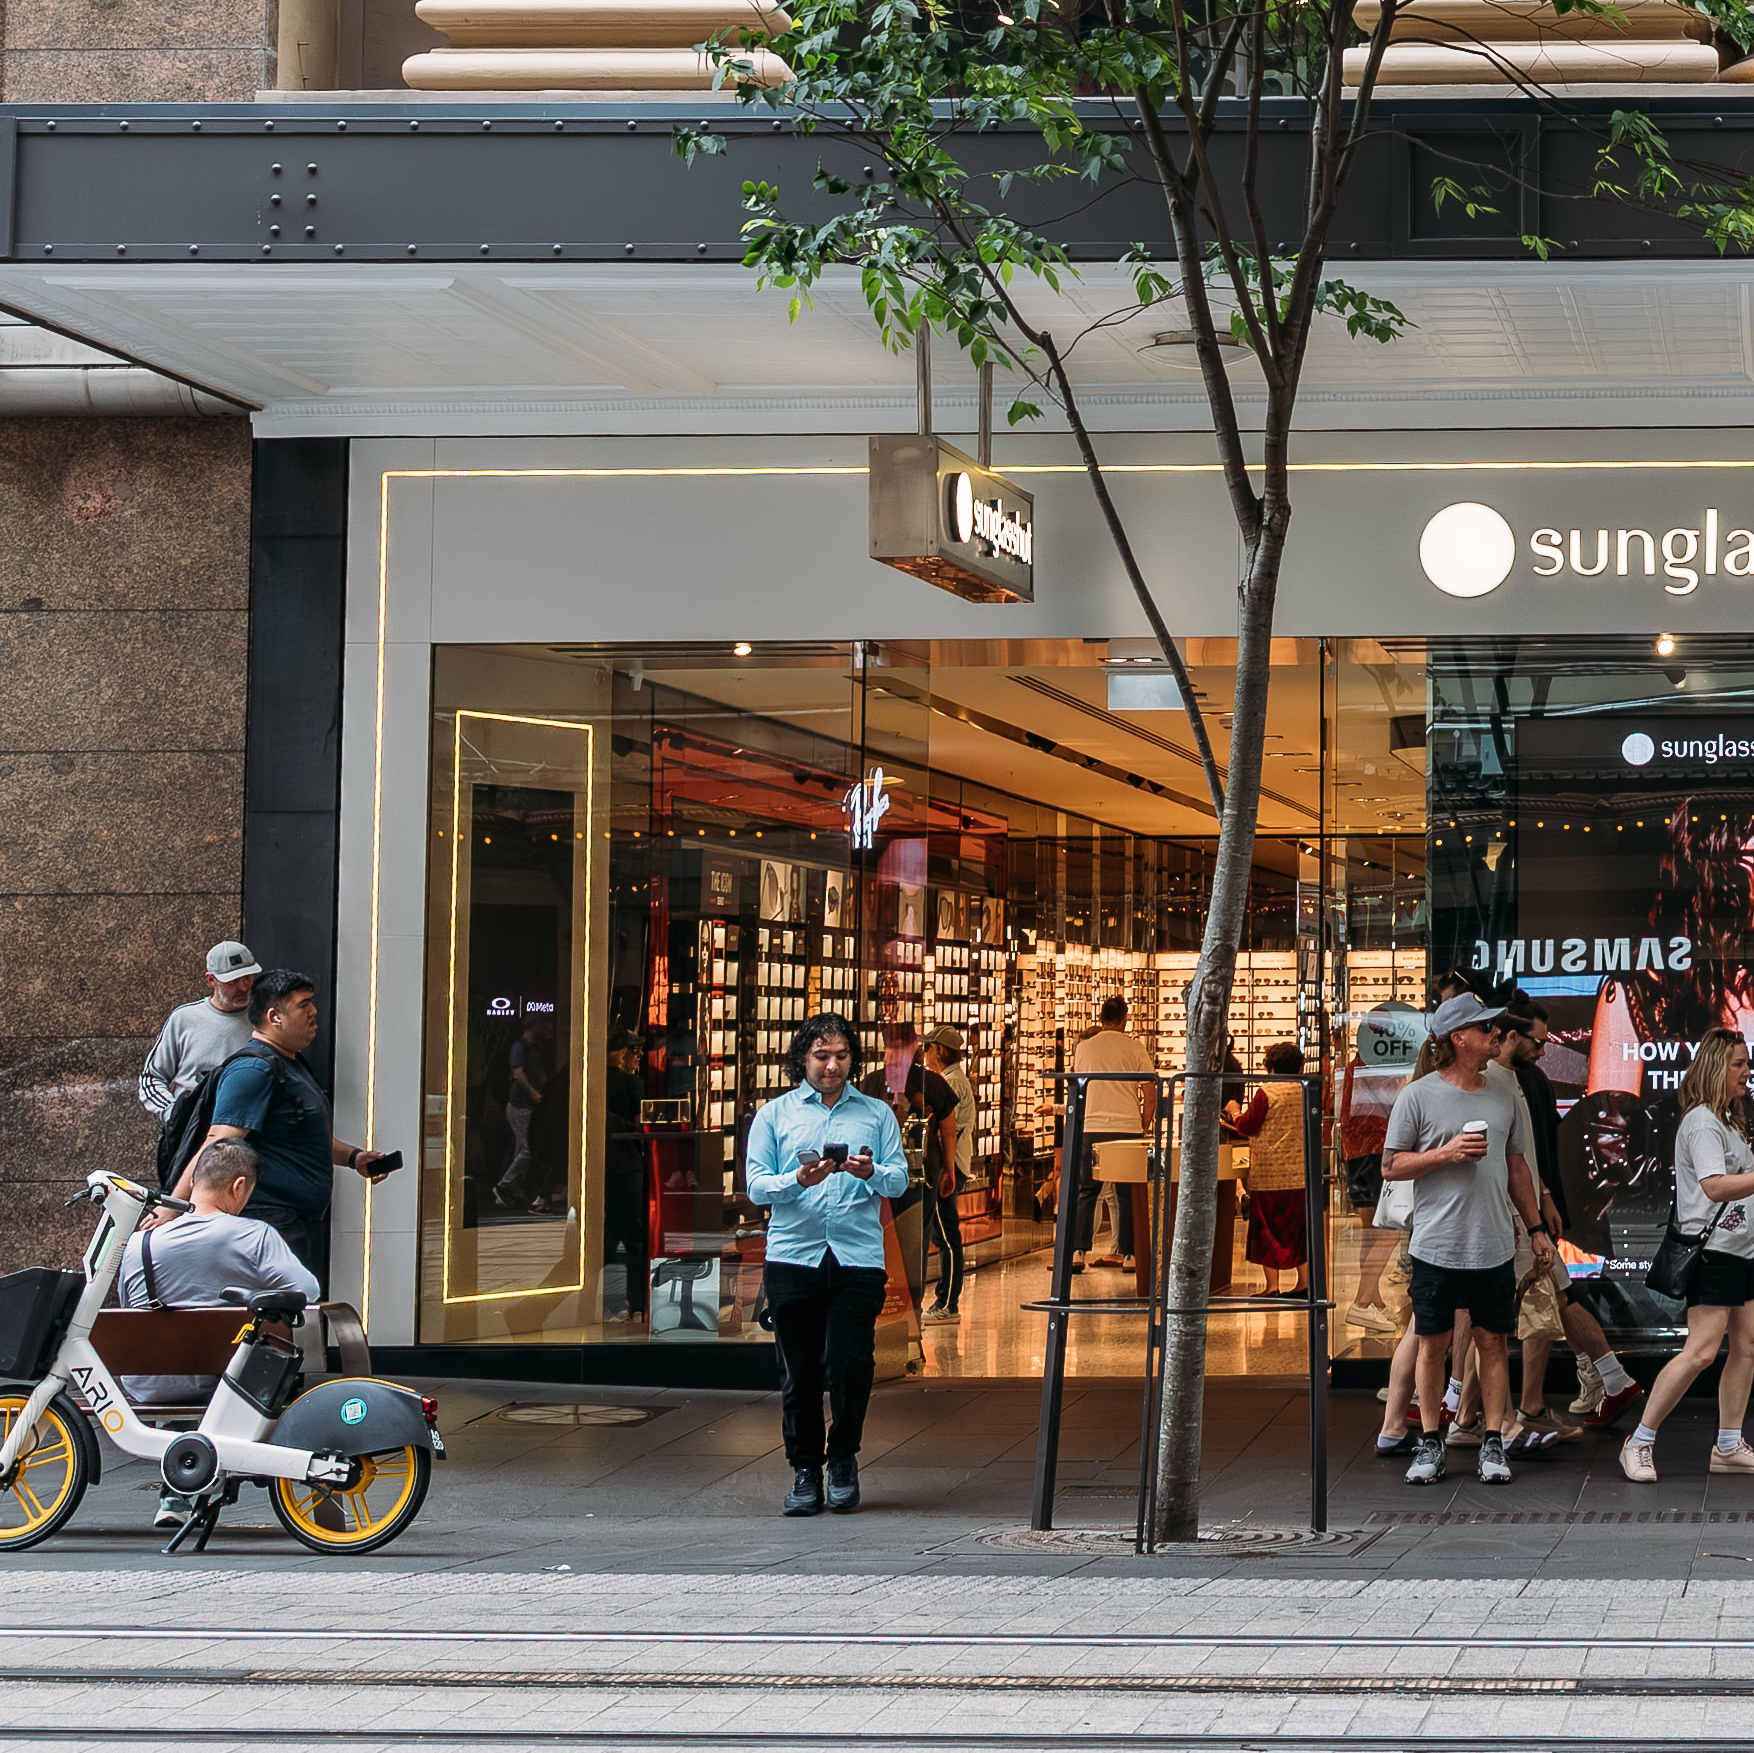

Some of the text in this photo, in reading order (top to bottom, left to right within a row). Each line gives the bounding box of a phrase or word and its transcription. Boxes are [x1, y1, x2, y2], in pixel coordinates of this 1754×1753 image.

[972, 497, 1033, 566] sunglasshut
[1374, 1021, 1416, 1038] 40%
[1373, 1039, 1413, 1057] OFF
[1622, 1041, 1680, 1062] HOW
[71, 1366, 124, 1433] ARIO
